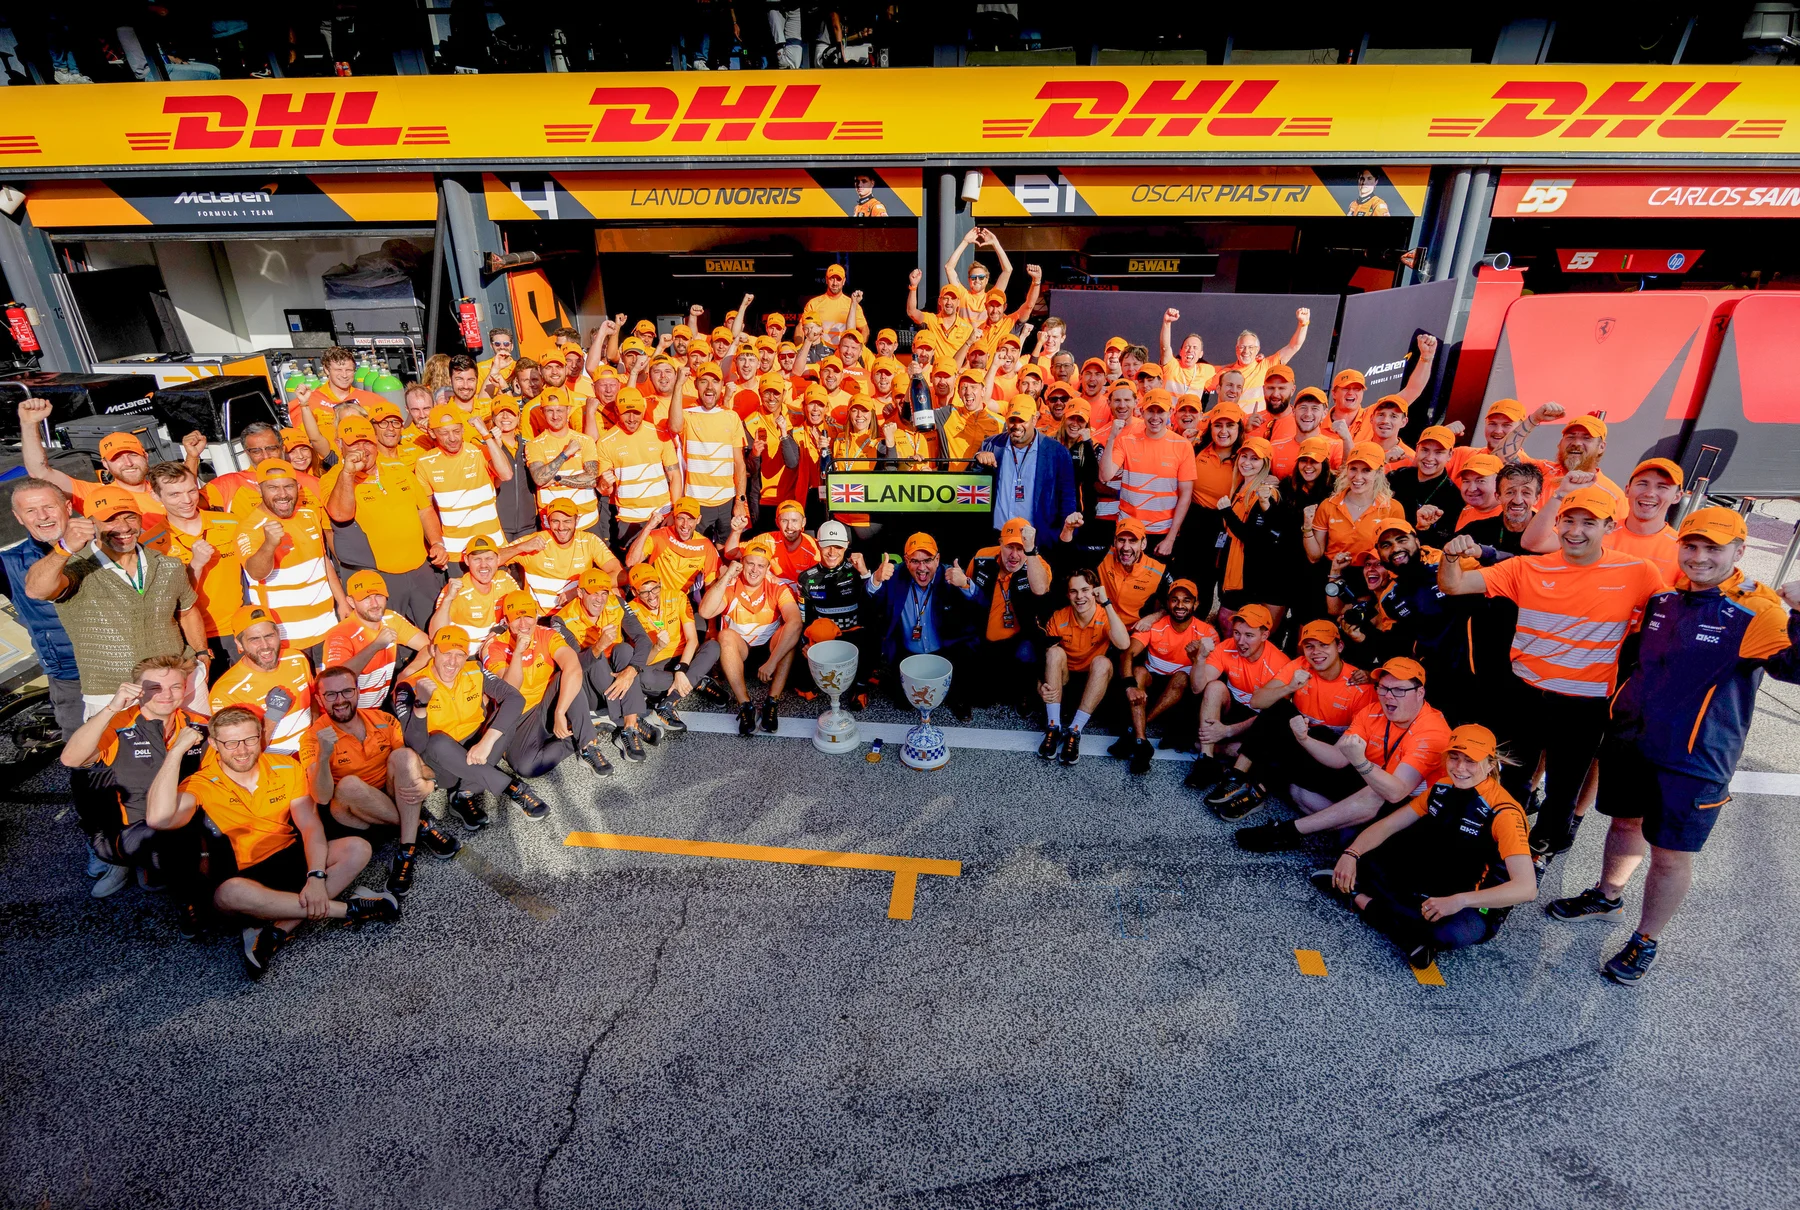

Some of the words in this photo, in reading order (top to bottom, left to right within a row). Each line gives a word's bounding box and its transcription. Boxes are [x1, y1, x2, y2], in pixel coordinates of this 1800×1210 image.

[589, 85, 838, 143] DHL
[1028, 80, 1287, 138] DHL
[1474, 81, 1742, 138] DHL
[162, 91, 403, 150] DHL
[174, 191, 271, 204] McLaren
[630, 188, 711, 206] LANDO
[714, 187, 804, 206] NORRIS
[1131, 184, 1214, 203] OSCAR
[1214, 184, 1313, 203] PIASTRI
[1516, 179, 1577, 213] 55
[1648, 187, 1747, 206] CARLOS
[1567, 252, 1599, 269] 55
[493, 302, 506, 315] 12
[1364, 359, 1406, 378] McLaren
[105, 397, 151, 415] McLaren
[344, 426, 352, 434] P1
[864, 484, 956, 503] LANDO
[1564, 496, 1575, 504] P1
[95, 498, 107, 508] P1
[1683, 519, 1694, 527] P1
[1696, 633, 1720, 644] OKX
[269, 794, 286, 804] OKX
[1460, 825, 1479, 836] OKX
